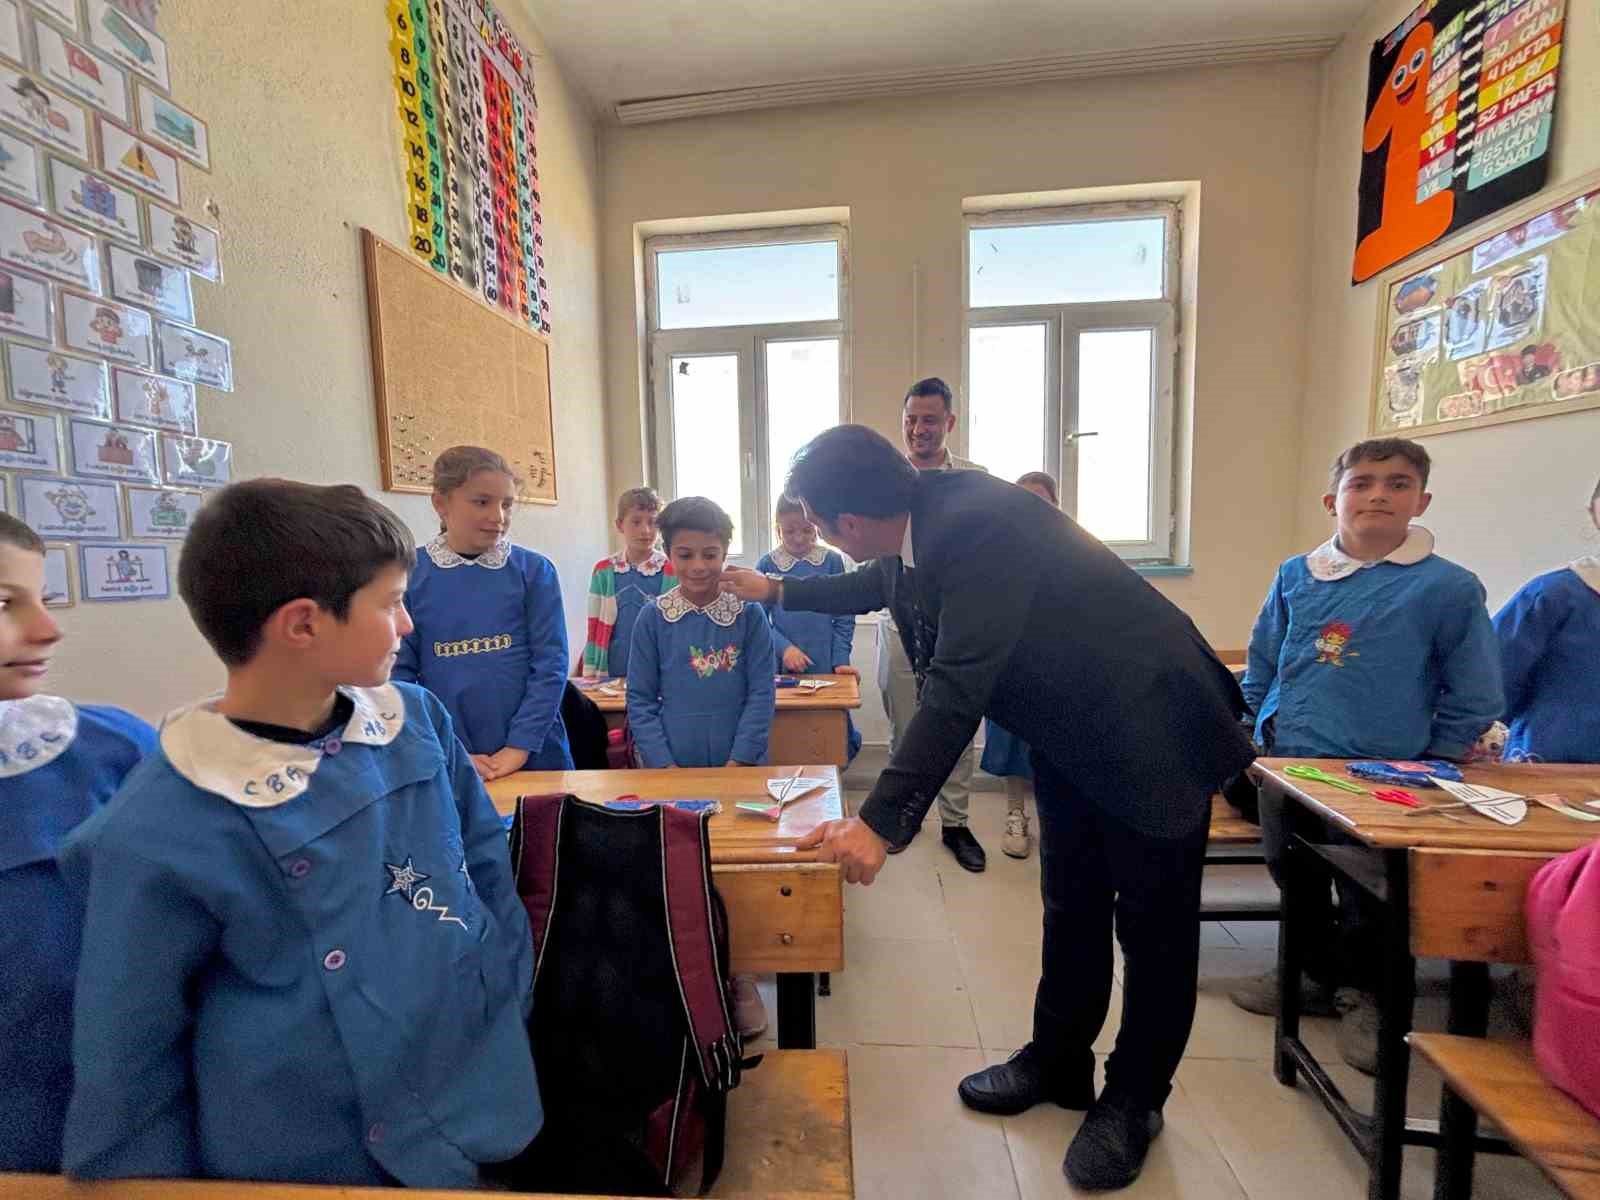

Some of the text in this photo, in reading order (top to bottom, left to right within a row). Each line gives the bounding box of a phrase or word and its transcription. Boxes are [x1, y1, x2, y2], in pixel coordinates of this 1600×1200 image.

[396, 12, 408, 31] 6
[400, 47, 410, 66] 8
[399, 76, 416, 97] 10
[404, 107, 420, 128] 12
[1478, 104, 1499, 129] 52
[409, 141, 425, 161] 14
[413, 172, 427, 192] 16
[415, 204, 429, 224] 18
[414, 235, 433, 254] 20
